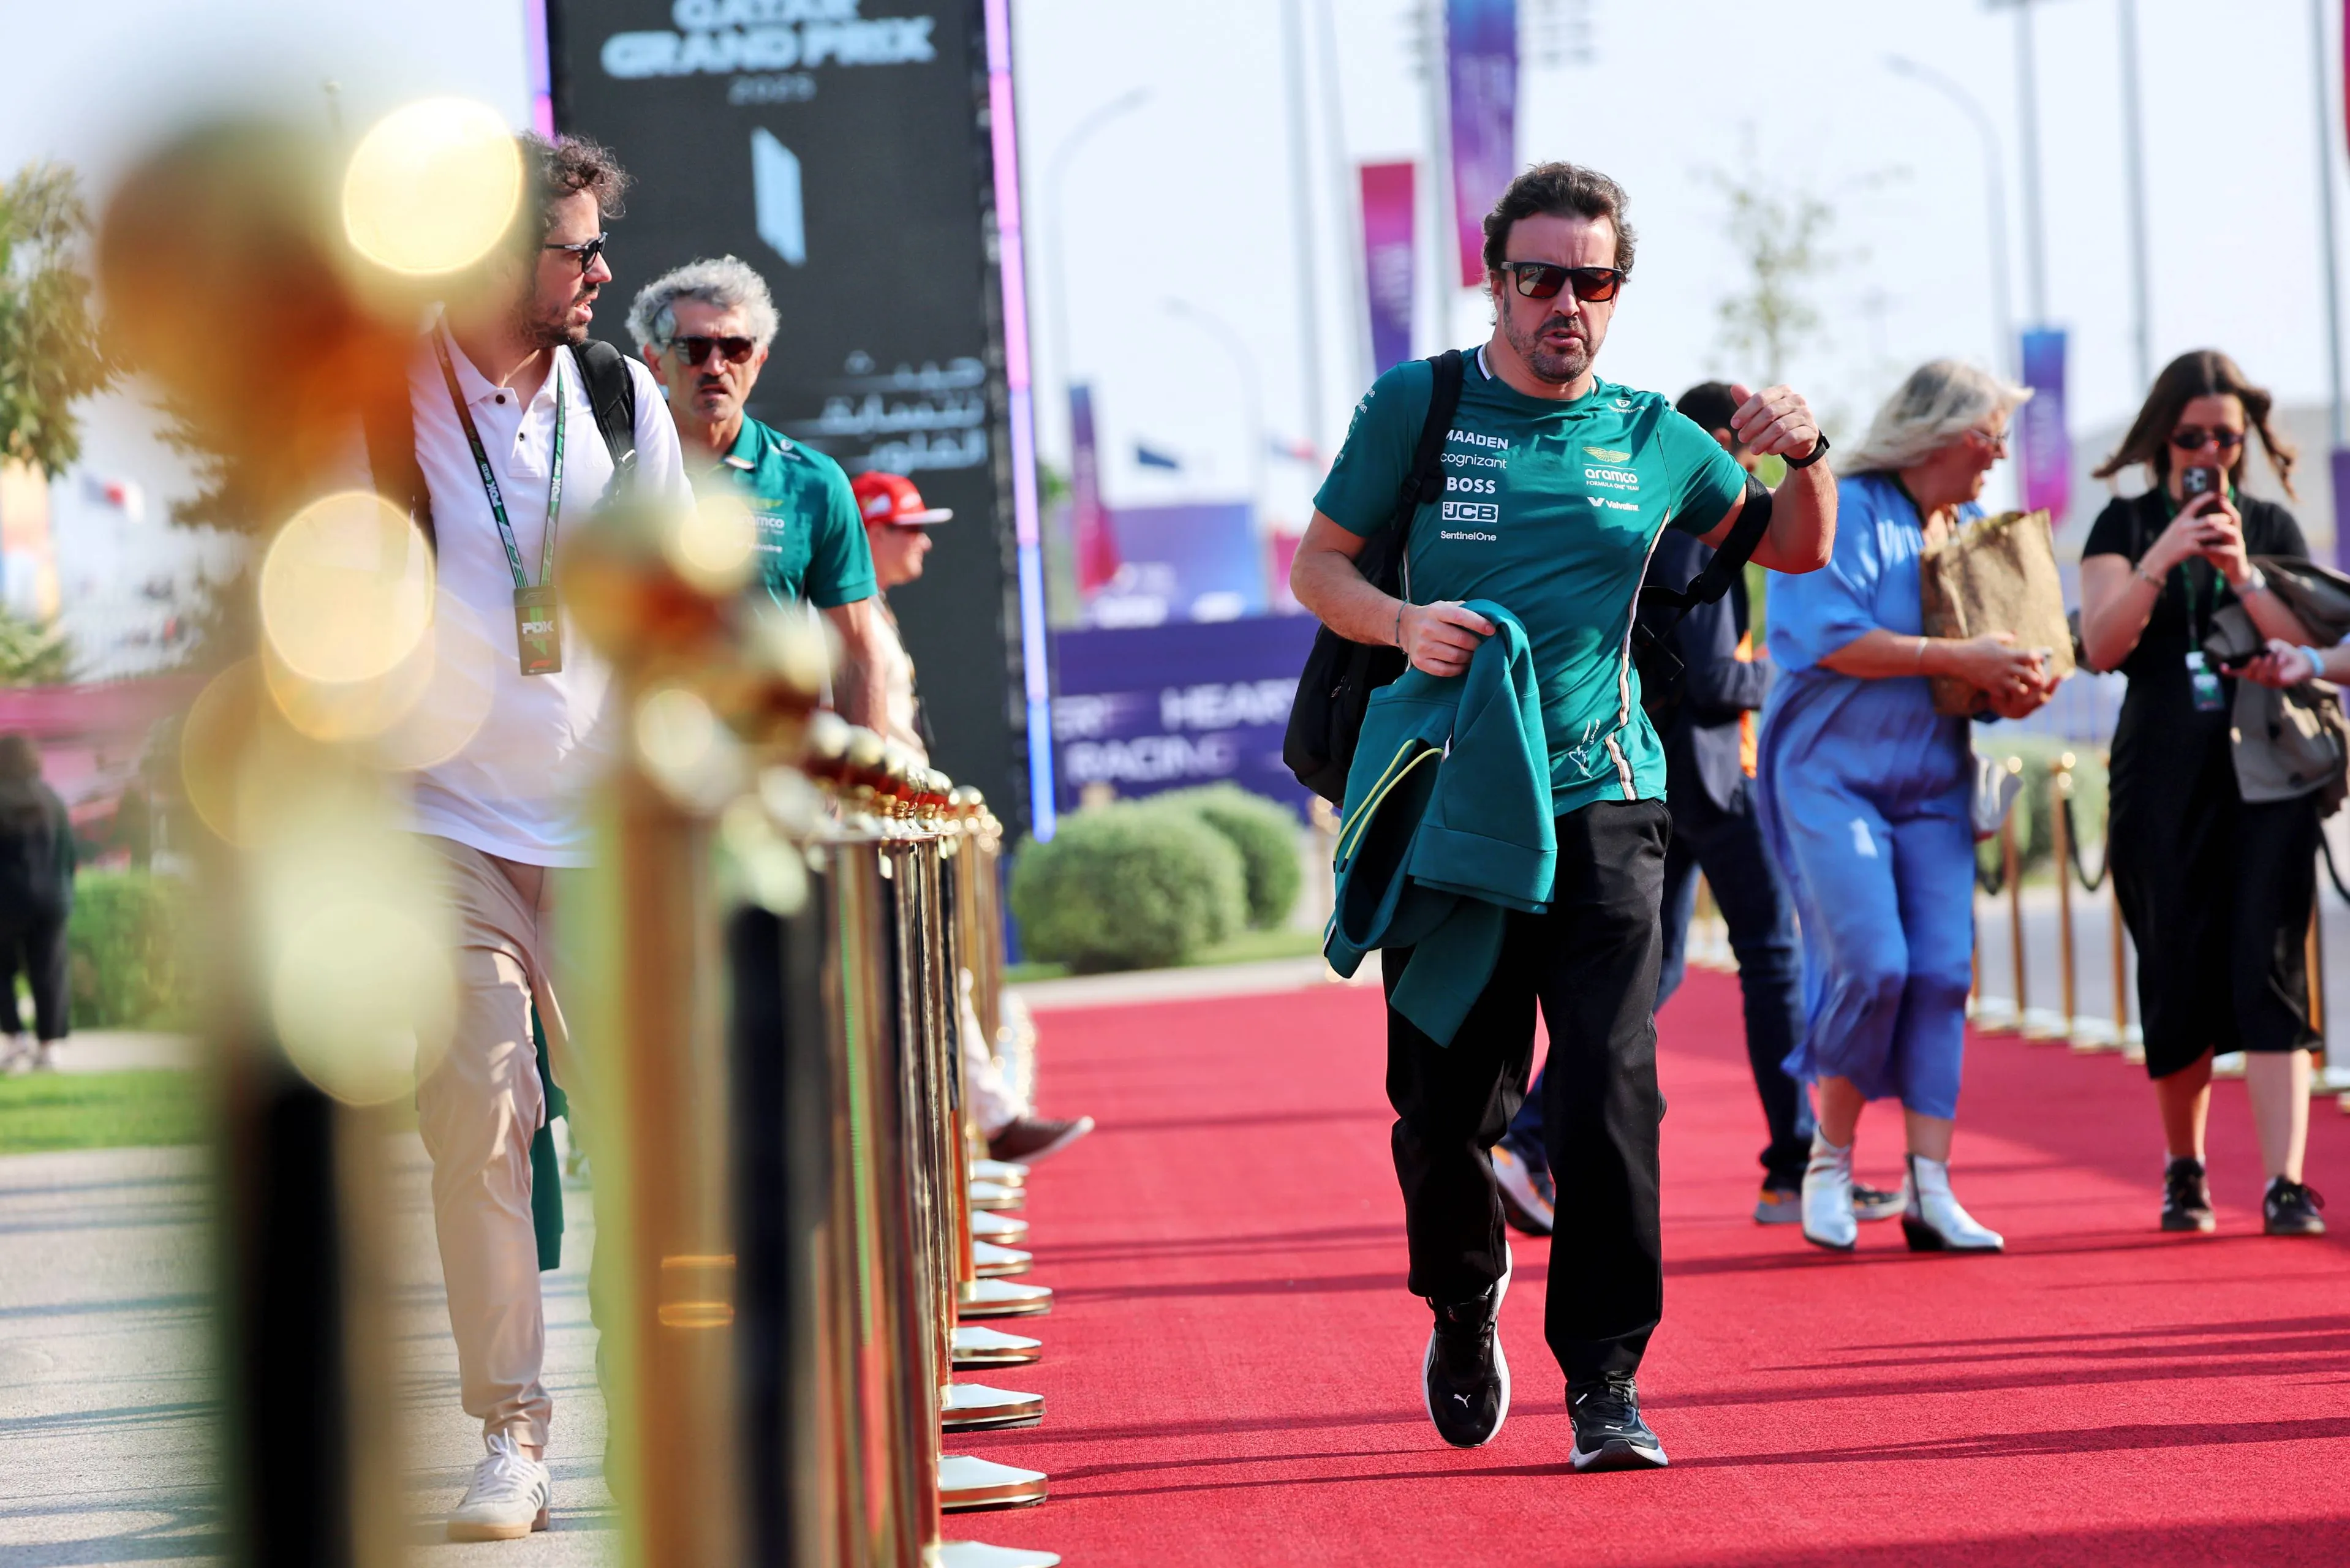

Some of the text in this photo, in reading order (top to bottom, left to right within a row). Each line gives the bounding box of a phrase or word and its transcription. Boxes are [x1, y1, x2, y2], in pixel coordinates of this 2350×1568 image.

[1440, 453, 1507, 469] cognizant
[1585, 469, 1638, 483] aramco
[1446, 477, 1495, 494] BOSS
[1444, 503, 1497, 521] JCB
[1605, 500, 1640, 511] Valvoline
[1440, 530, 1497, 541] SentinelOne
